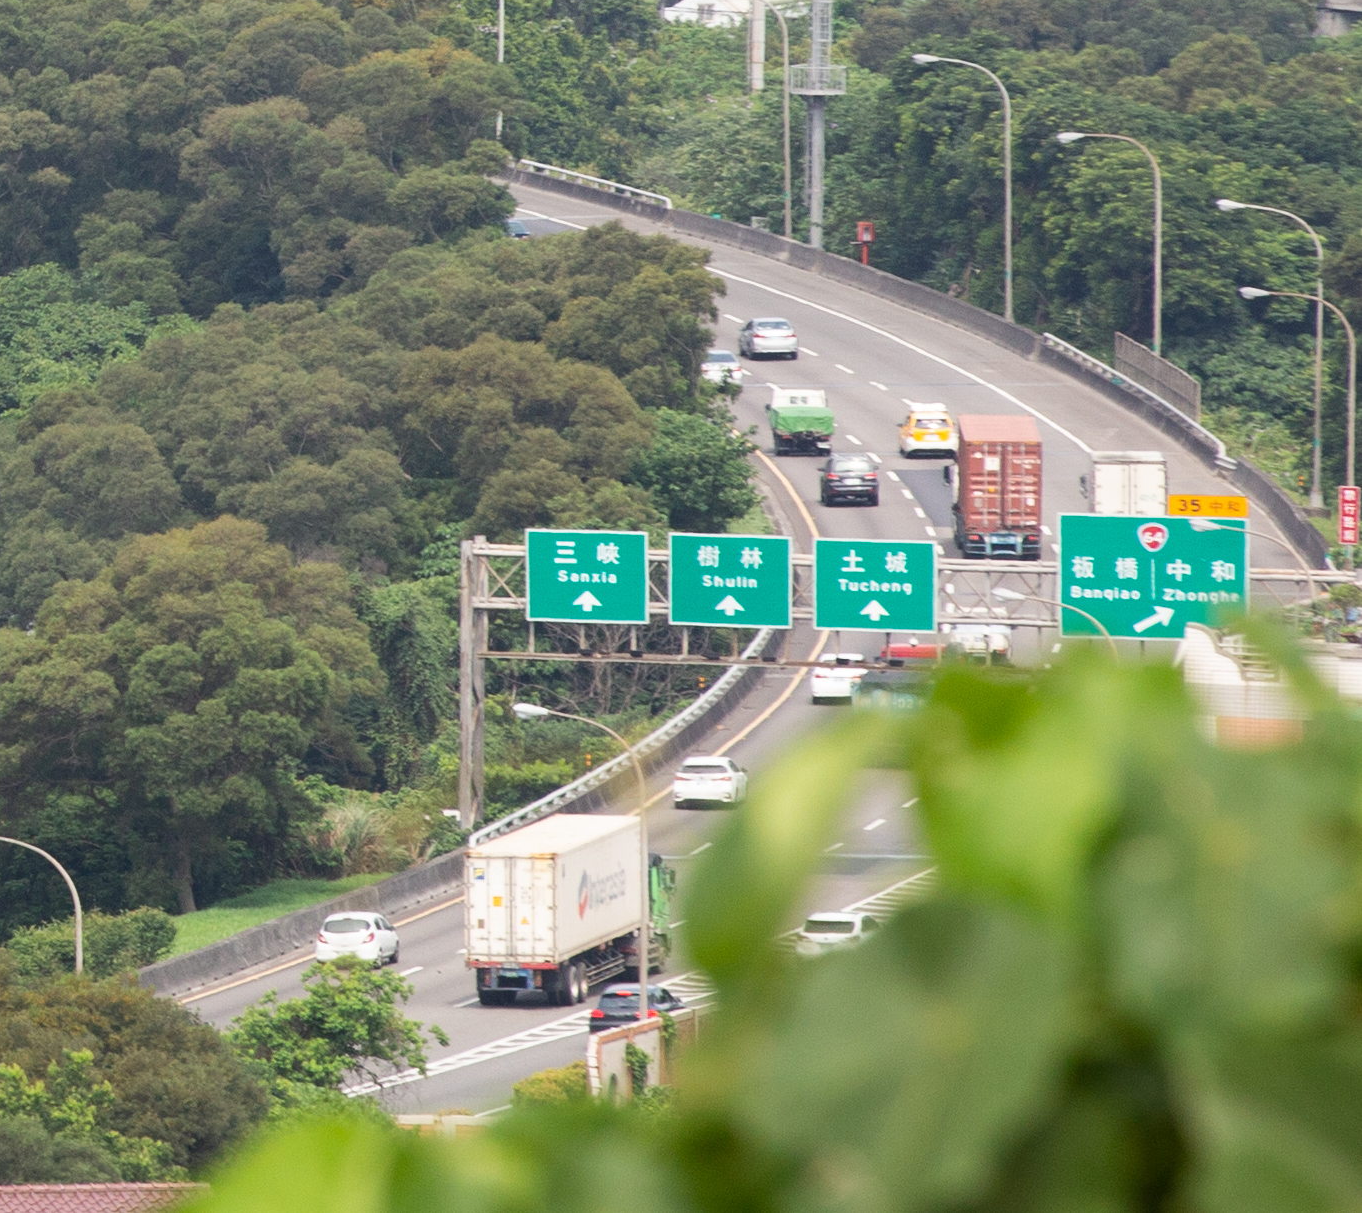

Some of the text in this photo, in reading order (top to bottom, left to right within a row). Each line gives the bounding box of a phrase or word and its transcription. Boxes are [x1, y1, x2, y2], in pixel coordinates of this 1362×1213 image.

[1178, 499, 1201, 512] 35
[1144, 531, 1164, 544] 64
[553, 540, 621, 565] 三峽
[696, 545, 764, 569] 樹林
[840, 549, 909, 574] 土城
[1070, 556, 1139, 580] 板橋
[557, 569, 618, 584] Sanxia
[1165, 558, 1236, 583] 中和
[701, 574, 758, 588] Shulin
[837, 578, 913, 596] Tucheng
[1069, 586, 1141, 602] Banqiao
[1162, 588, 1241, 605] Zhonghe
